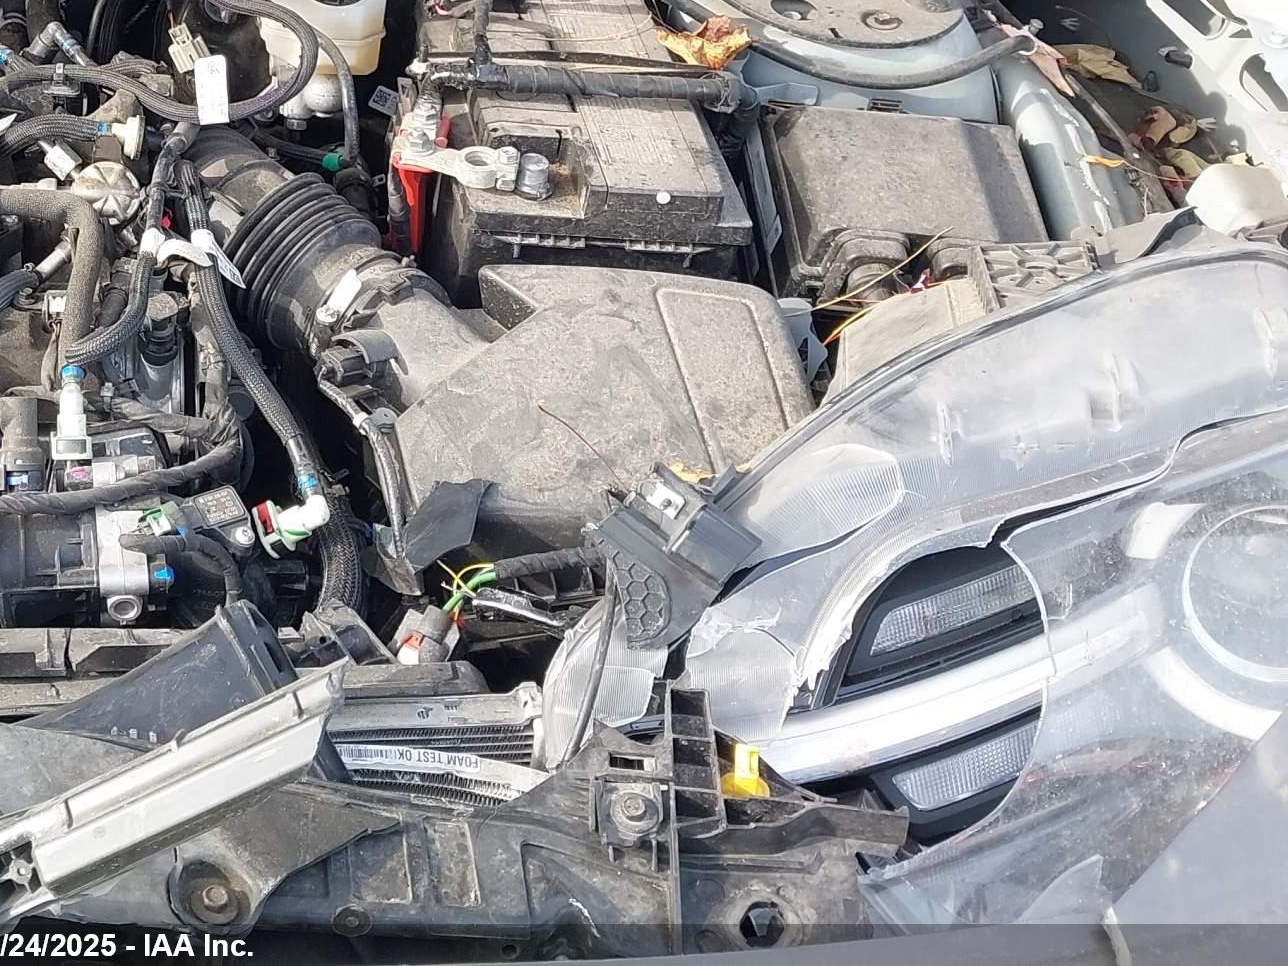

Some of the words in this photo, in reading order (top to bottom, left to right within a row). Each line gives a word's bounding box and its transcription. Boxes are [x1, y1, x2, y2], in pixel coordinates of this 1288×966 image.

[396, 748, 412, 760] OK
[416, 751, 442, 762] TEST
[446, 752, 480, 770] FOAM
